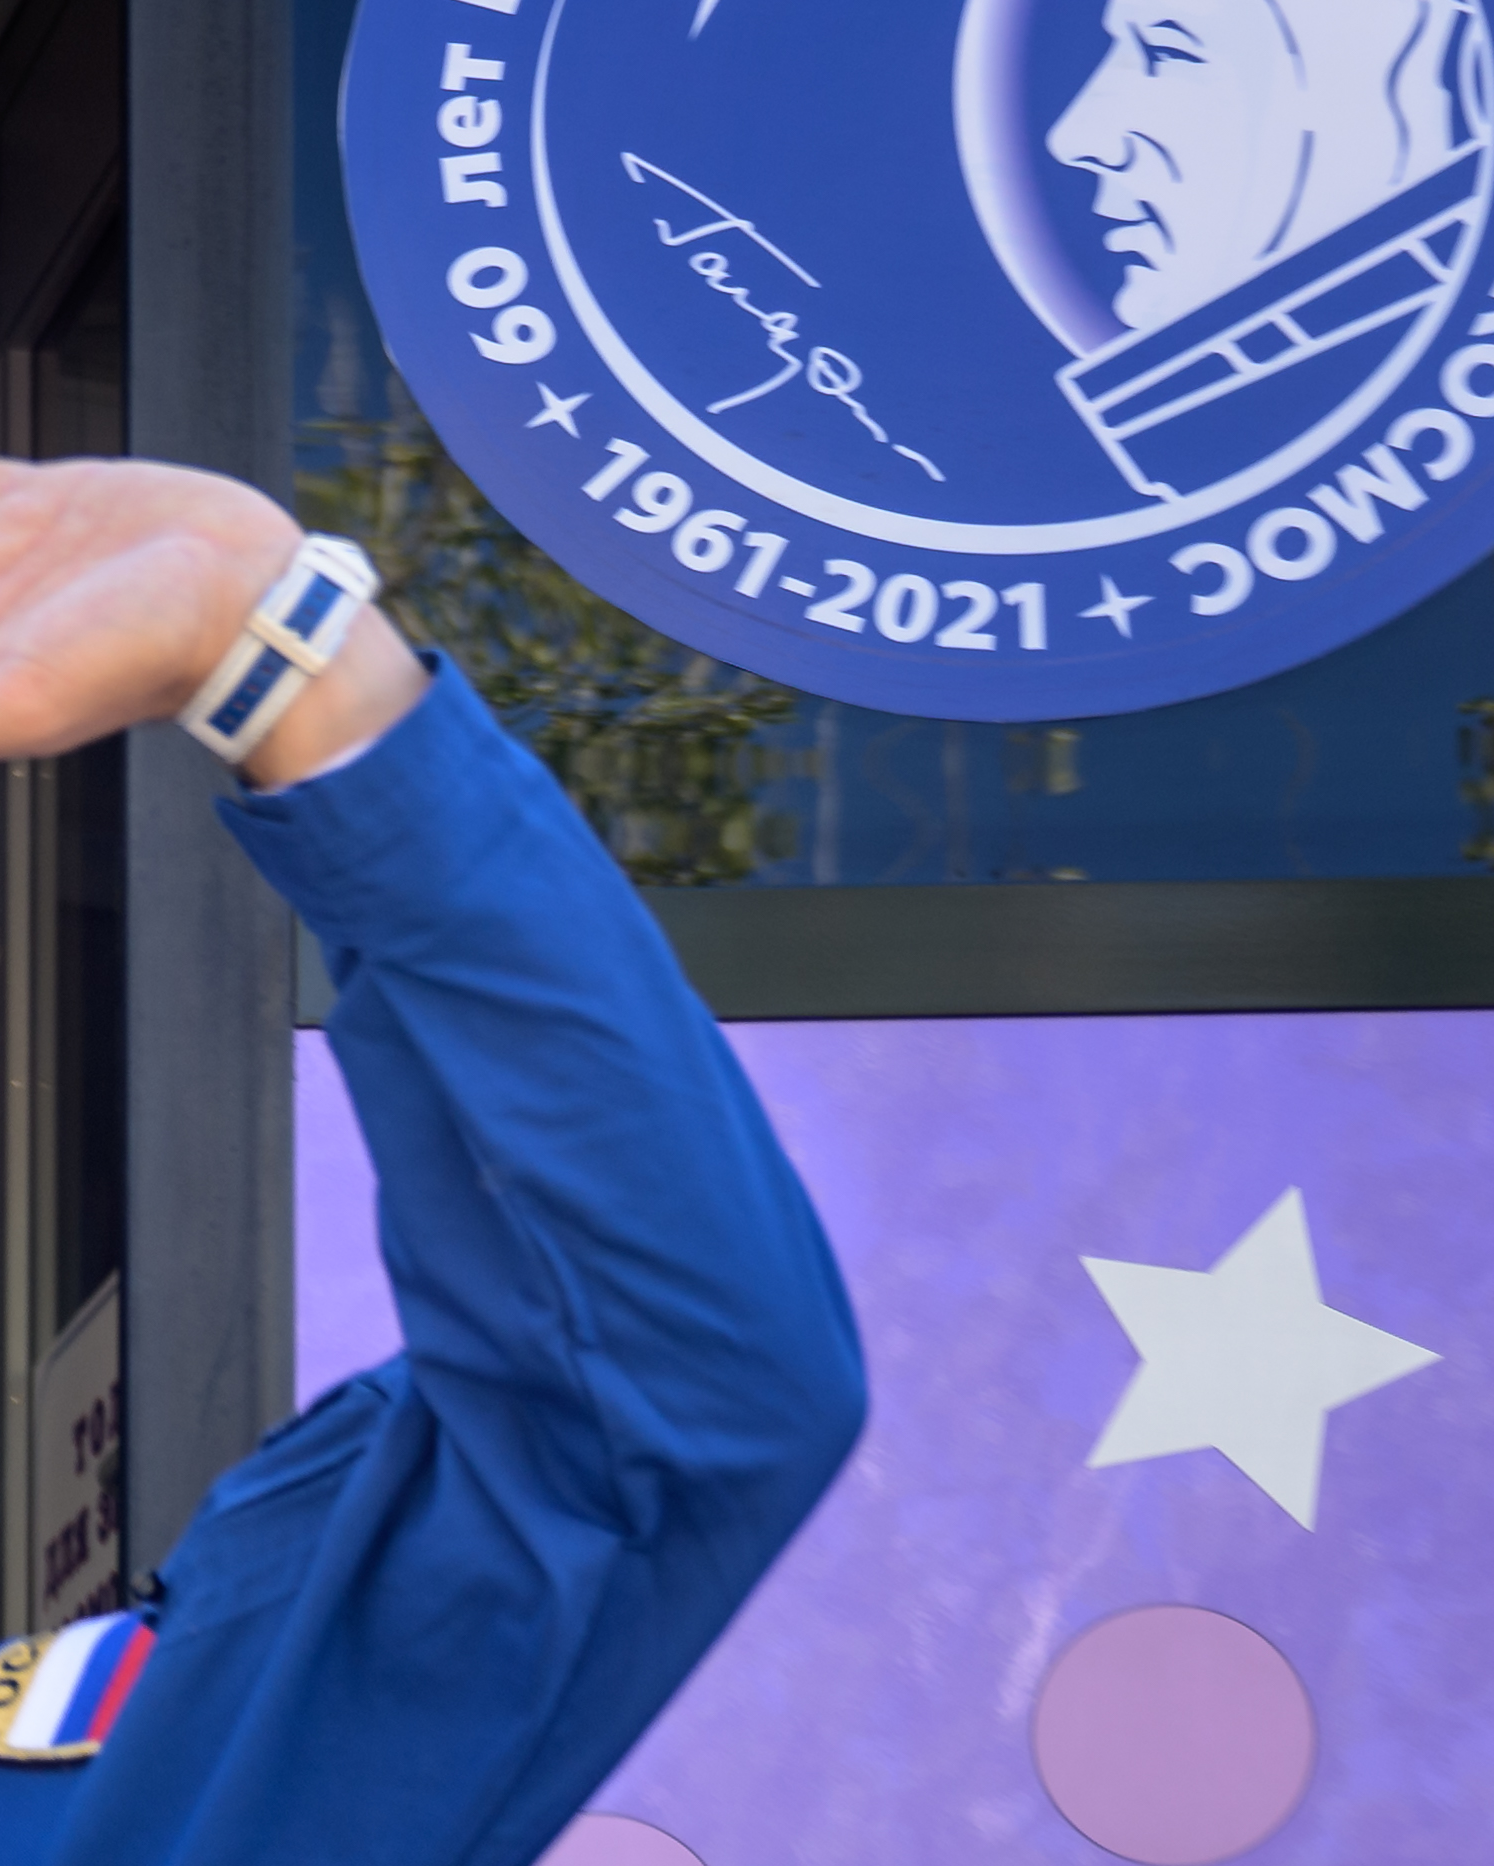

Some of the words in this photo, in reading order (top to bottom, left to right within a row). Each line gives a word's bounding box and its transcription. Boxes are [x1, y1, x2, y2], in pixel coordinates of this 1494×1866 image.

[436, 42, 507, 208] лет
[445, 246, 557, 364] 60
[580, 437, 1048, 652] 1961-2021
[1168, 285, 1494, 617] ОСМОС
